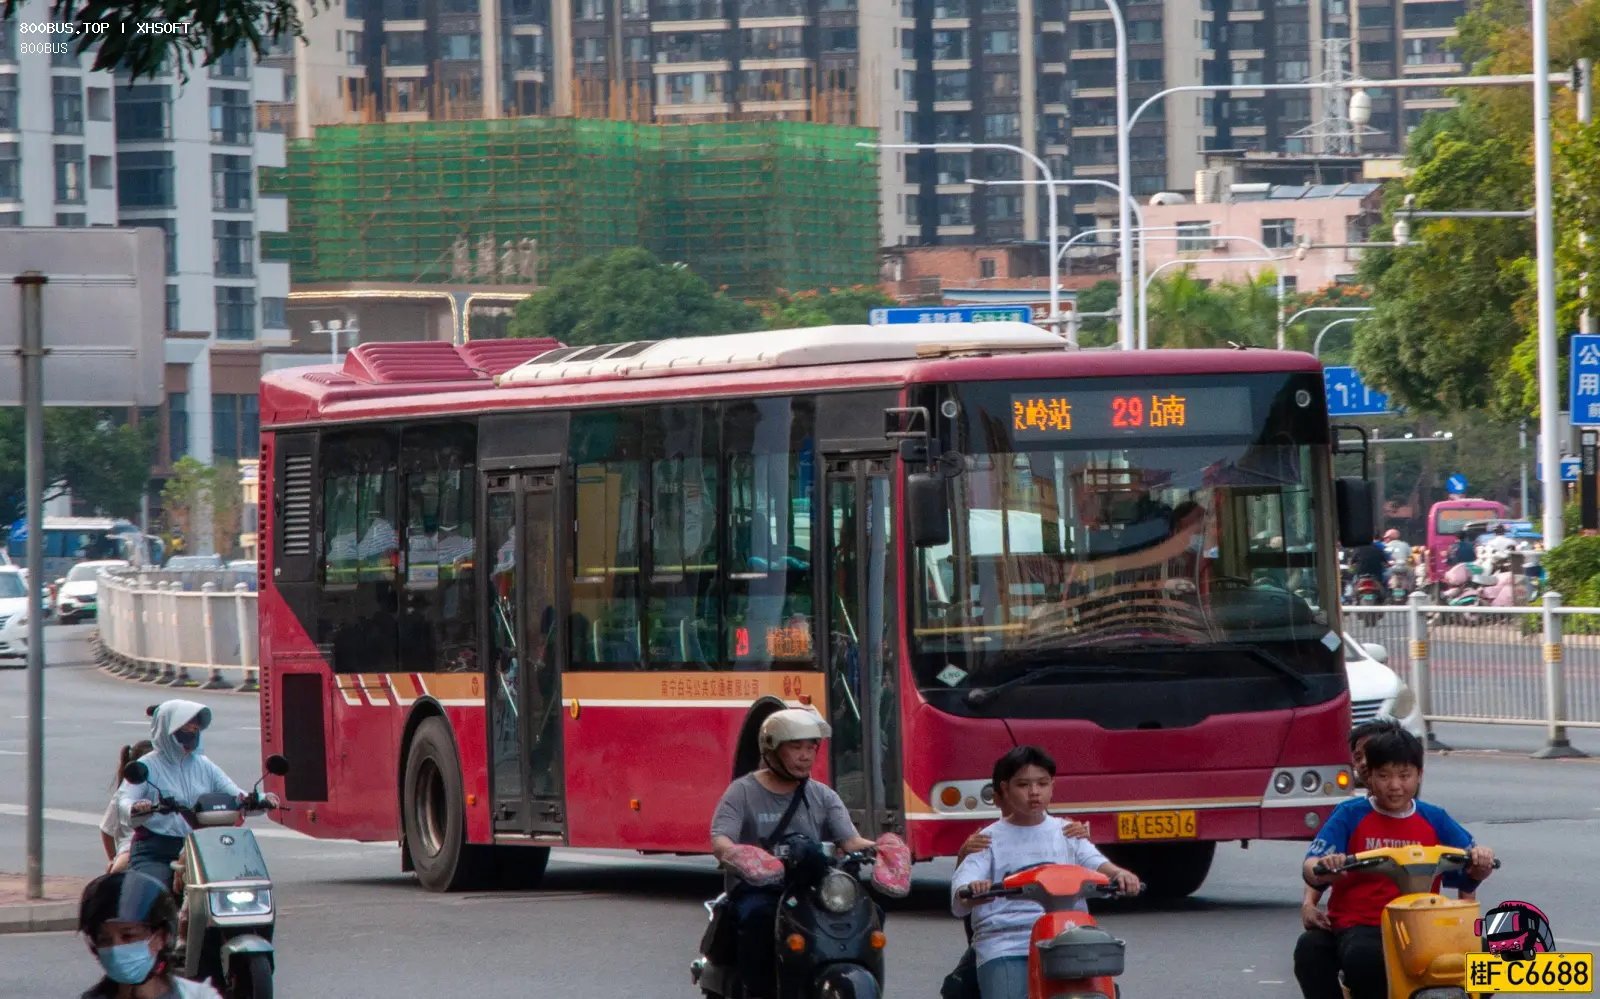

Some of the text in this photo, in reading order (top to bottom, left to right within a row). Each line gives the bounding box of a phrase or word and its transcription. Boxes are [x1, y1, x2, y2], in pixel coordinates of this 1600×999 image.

[1578, 343, 1600, 366] 公
[1577, 373, 1600, 396] 用
[1112, 396, 1143, 427] 29
[661, 679, 761, 697] 南宁白马公共交通有限公司
[1365, 838, 1422, 850] NATION
